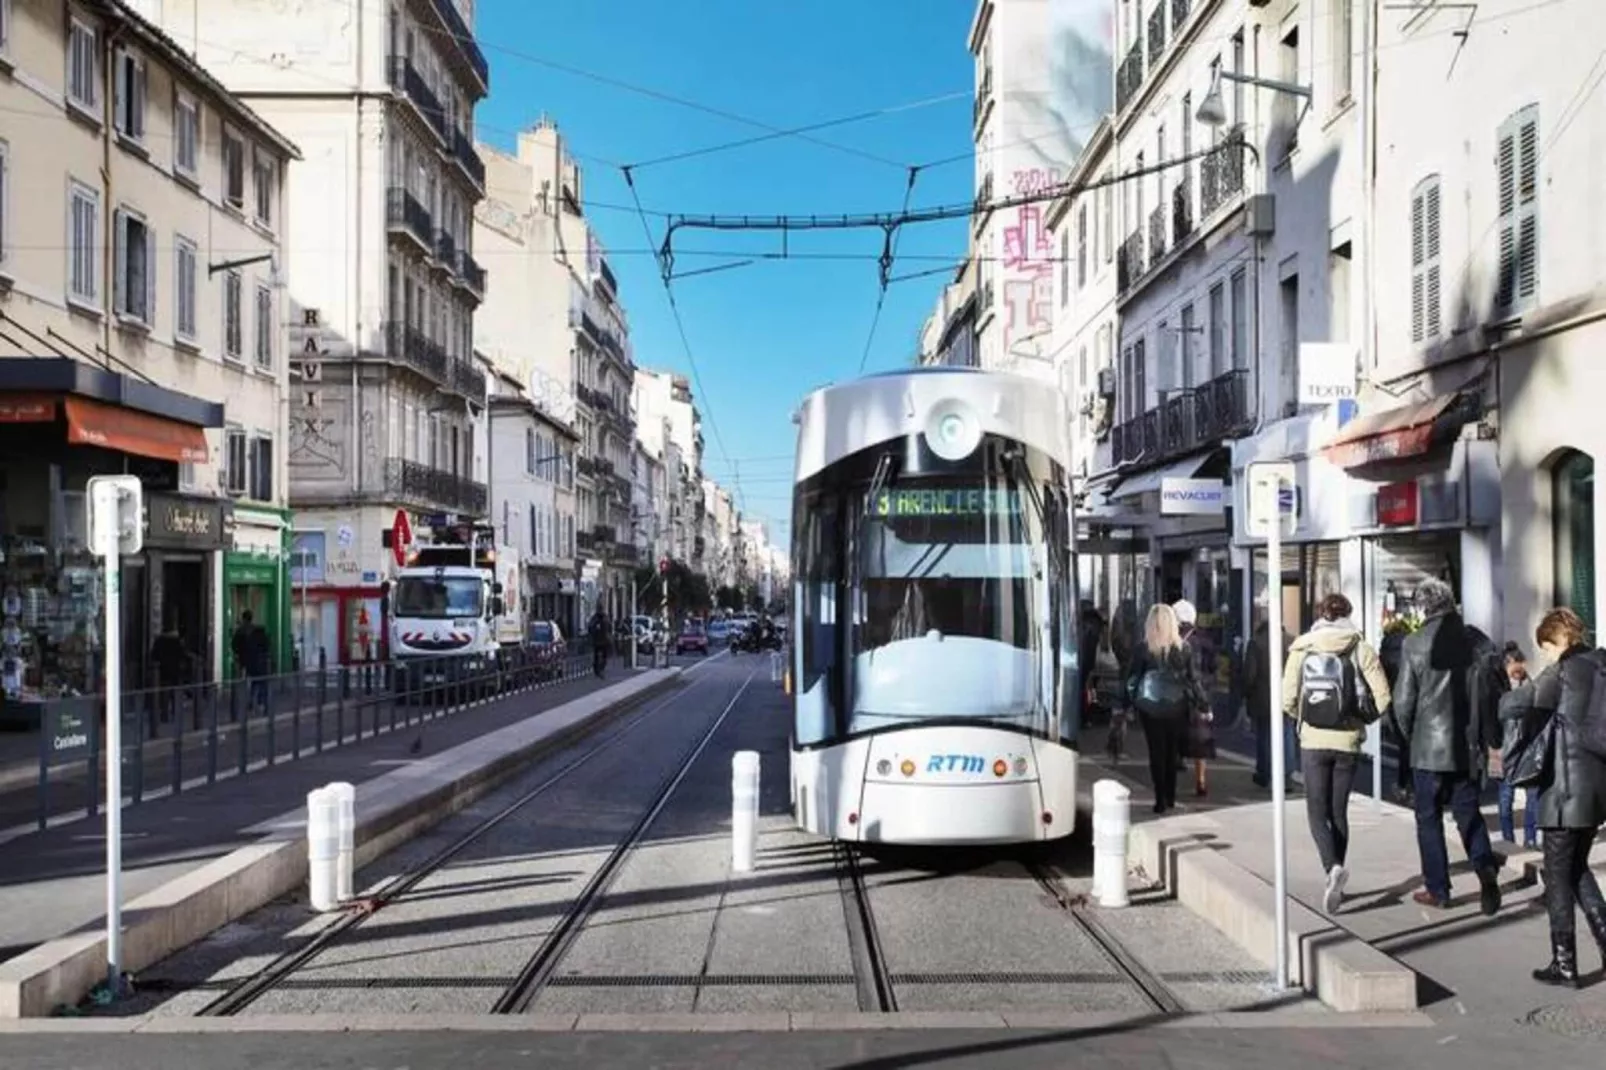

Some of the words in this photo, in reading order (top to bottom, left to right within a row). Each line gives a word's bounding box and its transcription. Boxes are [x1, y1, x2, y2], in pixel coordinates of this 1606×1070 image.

[1308, 384, 1352, 397] TEXTO
[899, 490, 951, 515] ARENC
[926, 754, 986, 773] RTM
